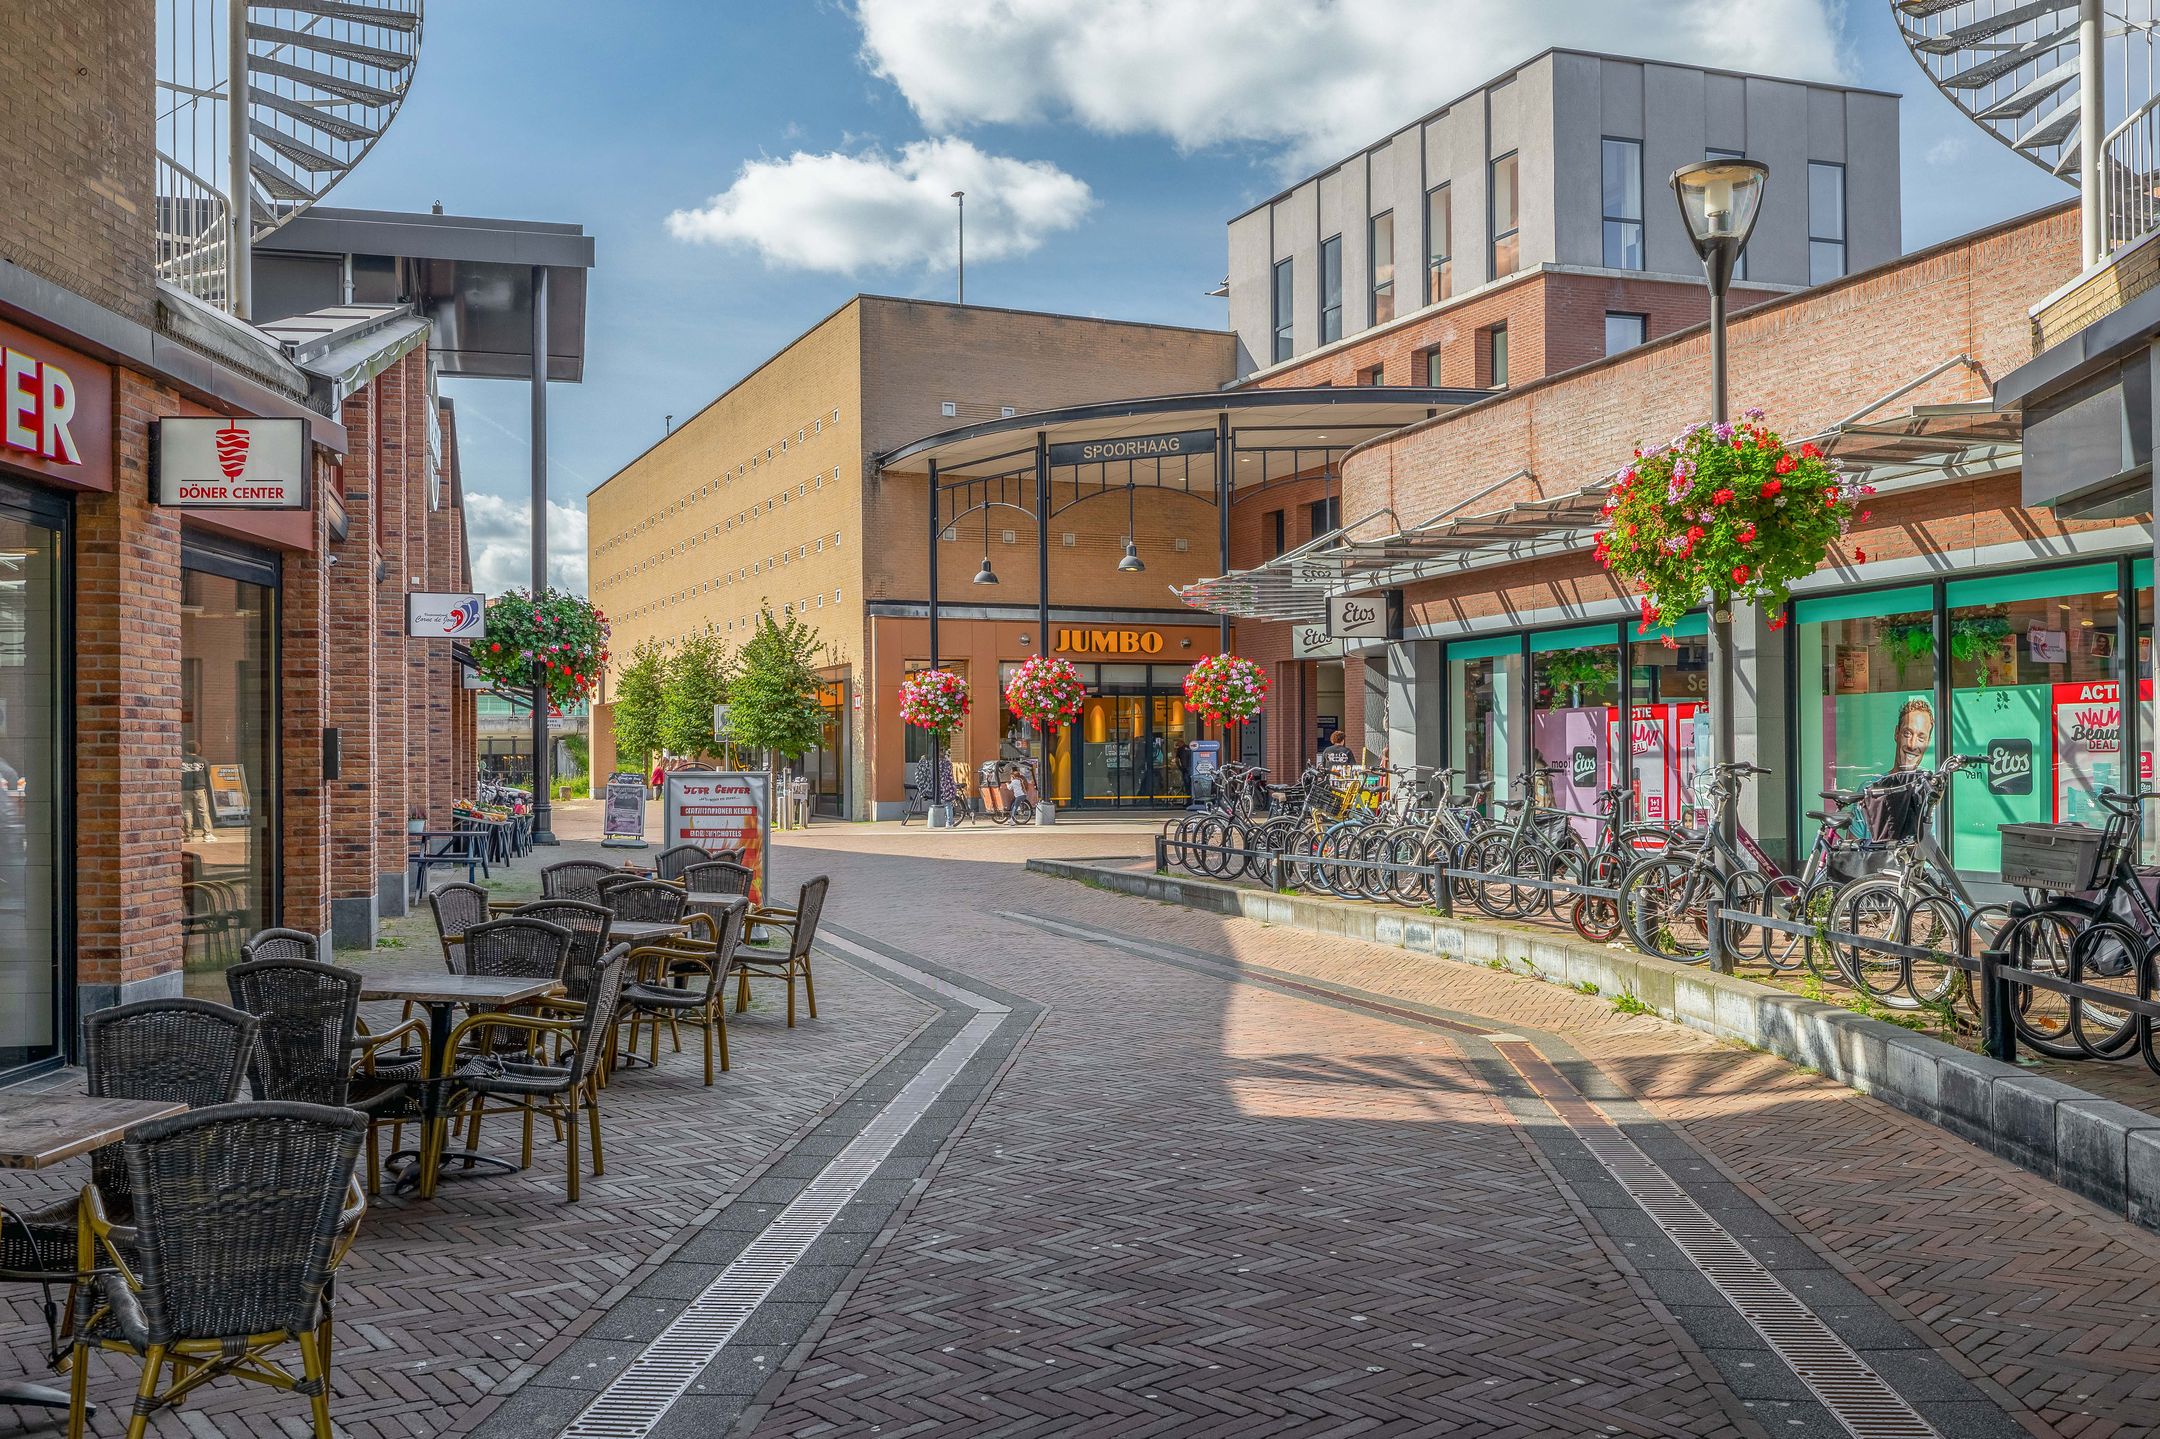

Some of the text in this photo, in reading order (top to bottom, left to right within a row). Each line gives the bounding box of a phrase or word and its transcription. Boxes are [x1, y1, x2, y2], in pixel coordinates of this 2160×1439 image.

[0, 345, 82, 465] ER
[1083, 437, 1180, 459] SPOORHAAG
[180, 483, 285, 499] DÖNER CENTER
[1342, 602, 1376, 623] Etos
[1055, 629, 1164, 654] JUMBO
[2080, 683, 2120, 700] ACTI
[1632, 742, 1646, 753] EAL
[2089, 740, 2115, 750] DEAL
[1574, 752, 1596, 773] Etos
[1990, 747, 2030, 775] Etos
